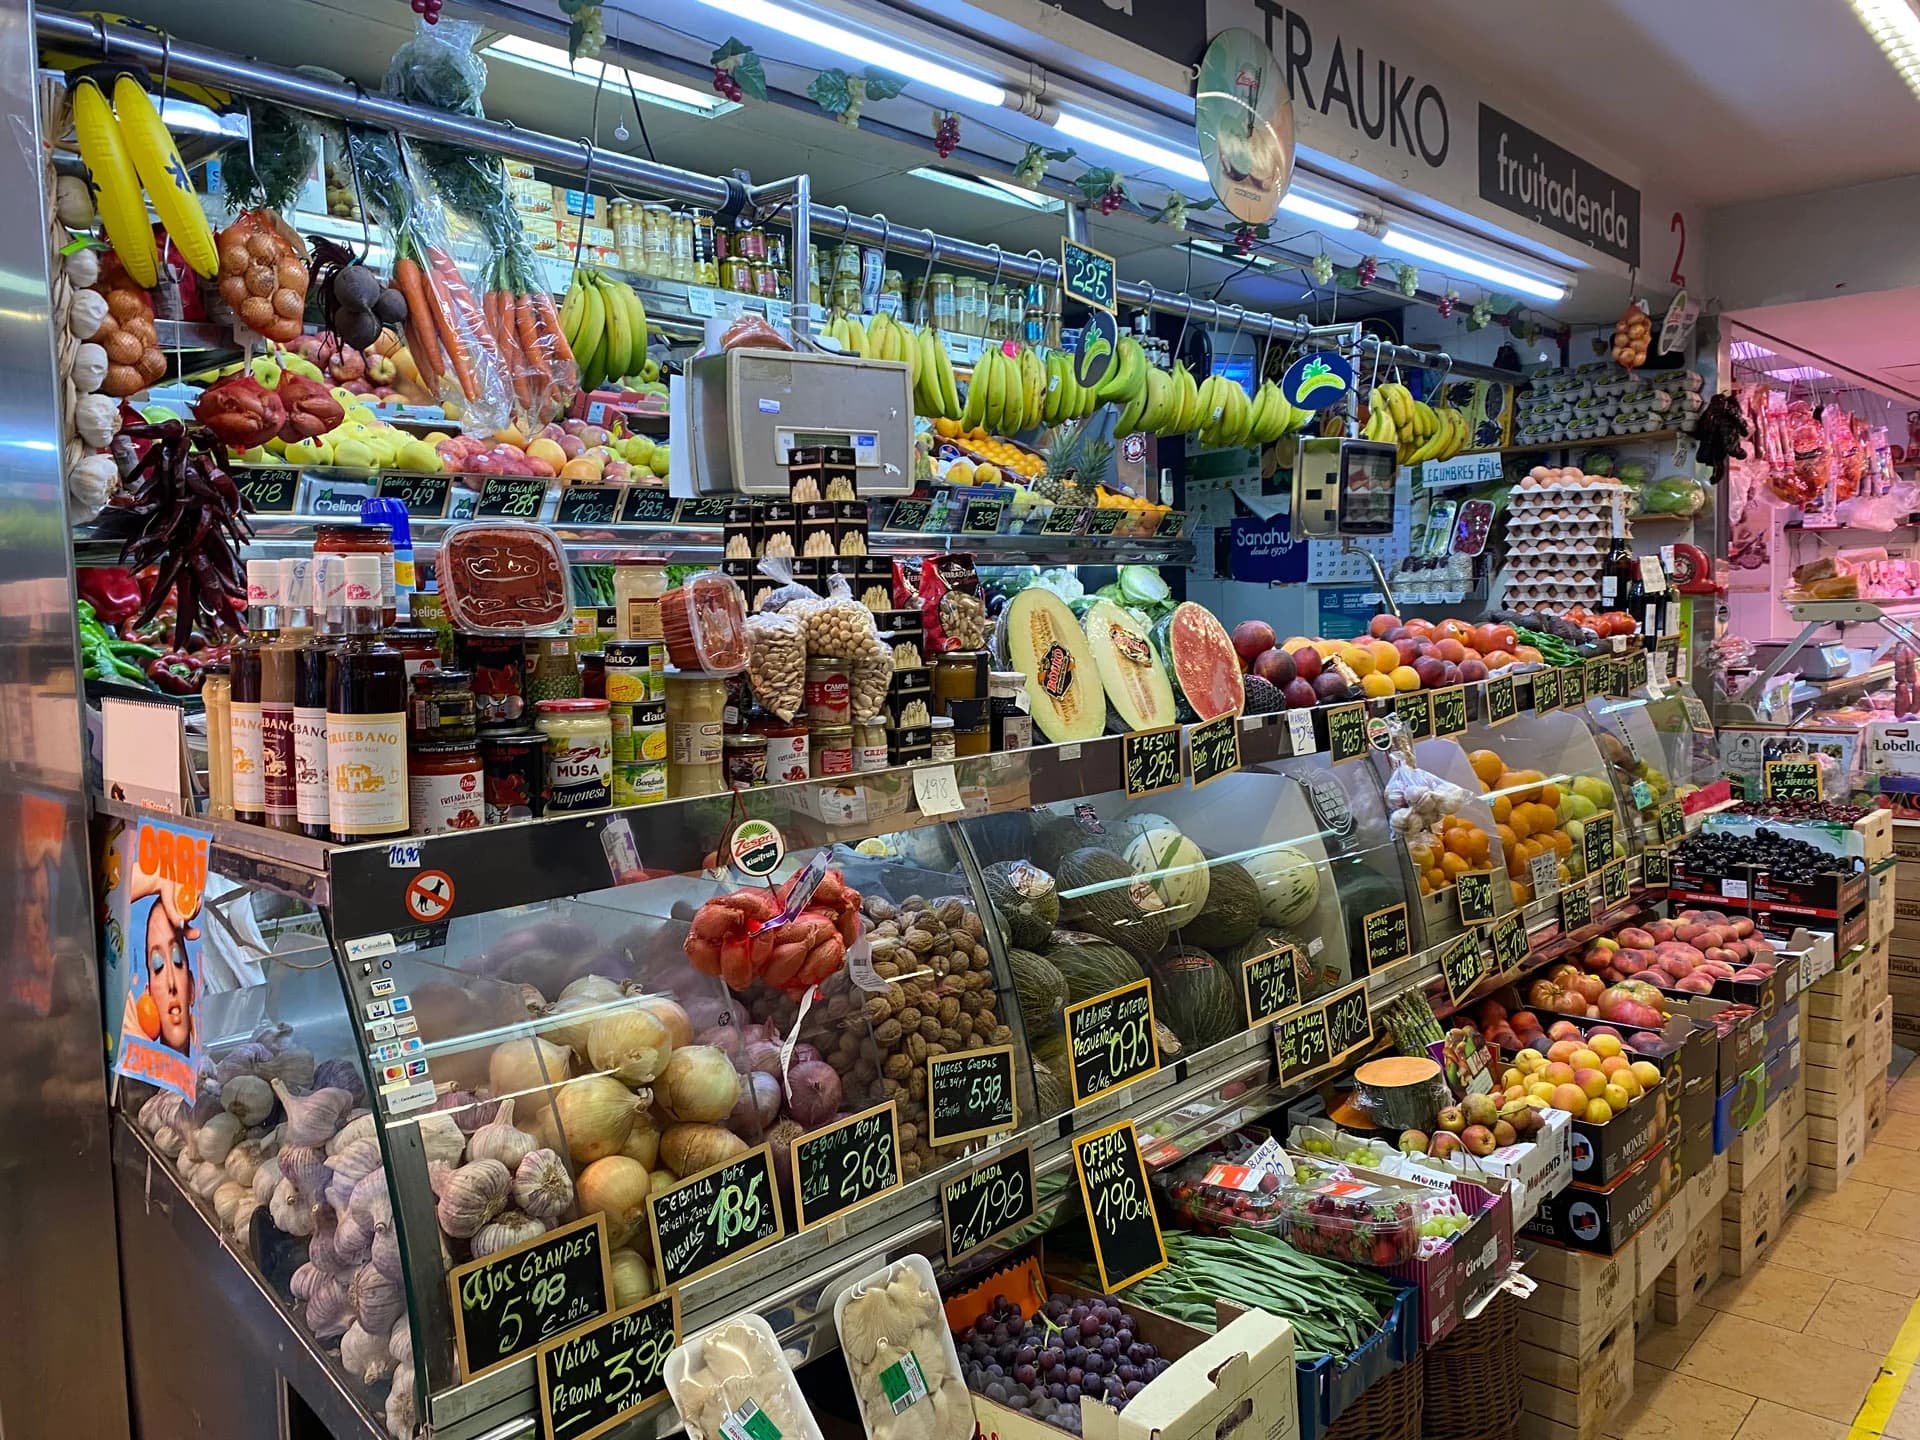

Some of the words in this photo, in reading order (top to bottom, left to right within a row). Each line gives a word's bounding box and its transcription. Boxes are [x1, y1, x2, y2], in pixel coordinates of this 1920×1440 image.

[1254, 0, 1449, 168] TRAUKO
[1497, 132, 1628, 249] fruitadenda
[1132, 731, 1176, 755] FRESON
[556, 764, 599, 778] MUSA
[551, 787, 606, 808] Mayonesa
[734, 831, 775, 858] Zespri
[375, 982, 392, 991] VISA
[1109, 1014, 1151, 1079] 0,95
[934, 1059, 964, 1078] NUECES
[968, 1074, 1003, 1113] 5,98
[854, 1116, 881, 1140] ROJA
[1082, 1128, 1127, 1168] OFERTA
[839, 1133, 892, 1203] 2,68
[970, 1164, 1003, 1192] MORADA
[706, 1170, 764, 1249] 1,85
[967, 1171, 1025, 1240] 1,98
[551, 1375, 603, 1416] PERONA
